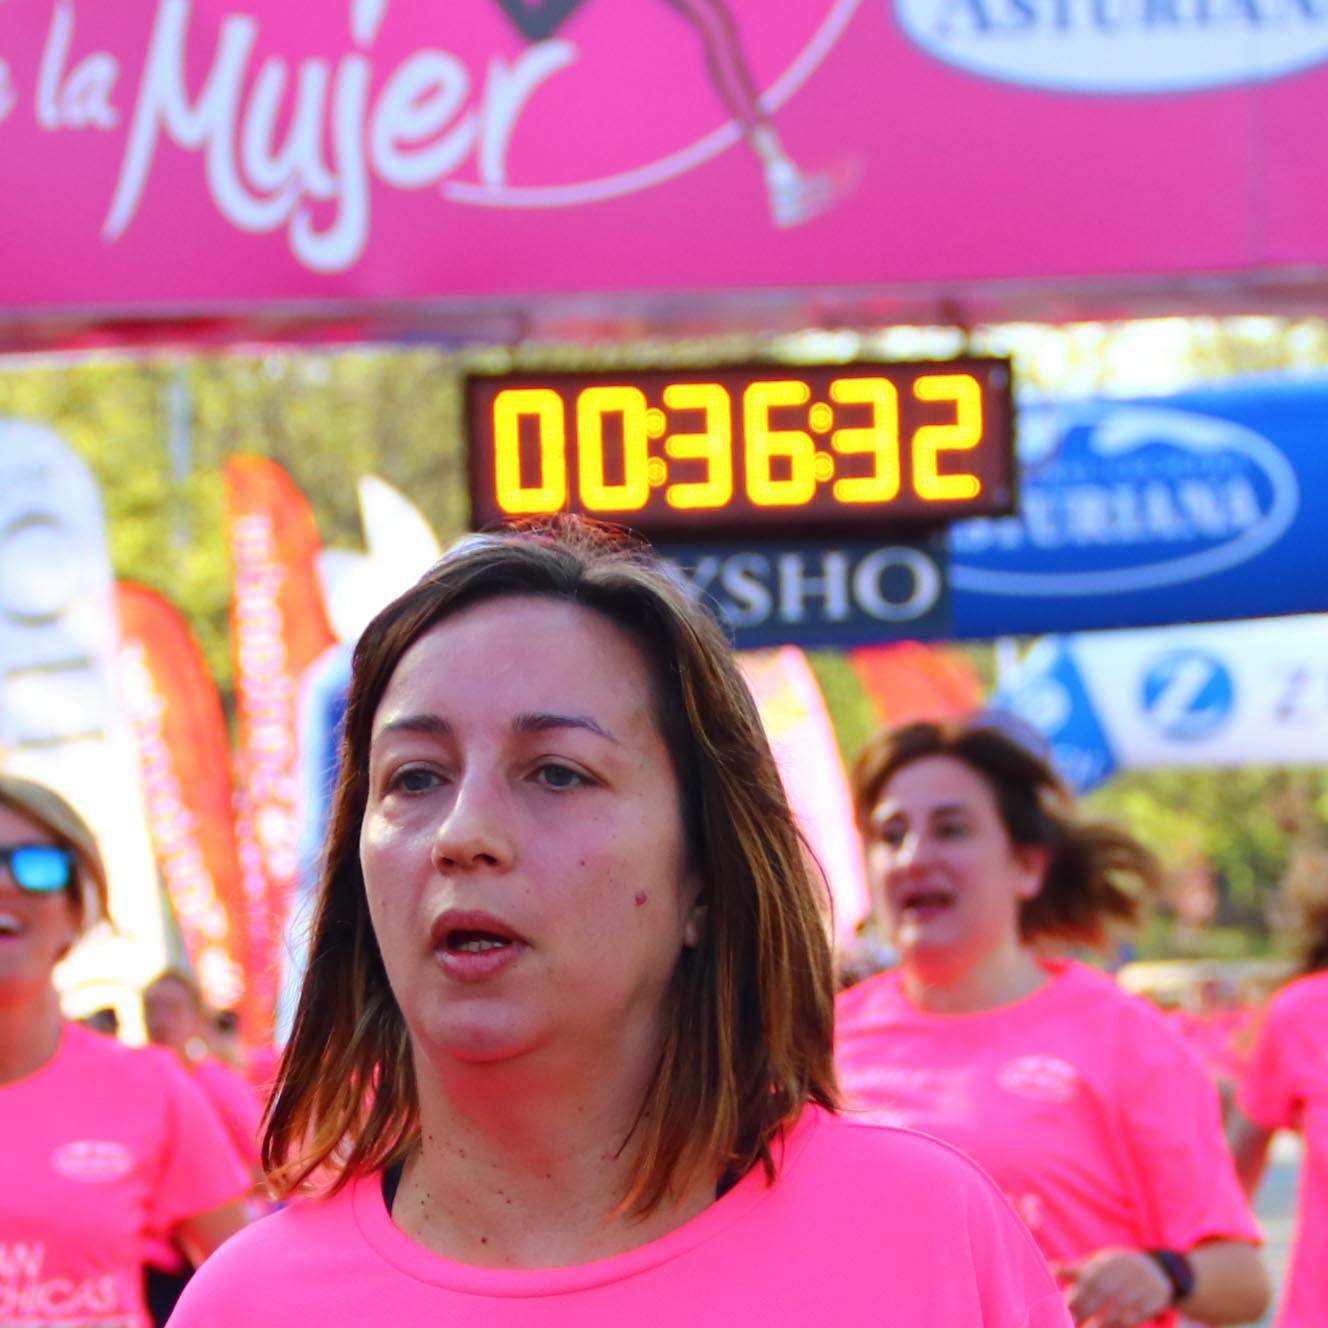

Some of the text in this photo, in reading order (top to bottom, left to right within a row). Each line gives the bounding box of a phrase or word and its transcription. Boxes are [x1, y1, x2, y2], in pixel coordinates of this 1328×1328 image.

[36, 0, 119, 131] la
[100, 0, 578, 274] Mujer
[493, 374, 983, 514] 00:36:32
[950, 474, 1264, 550] URIANA
[672, 546, 942, 628] YSHO
